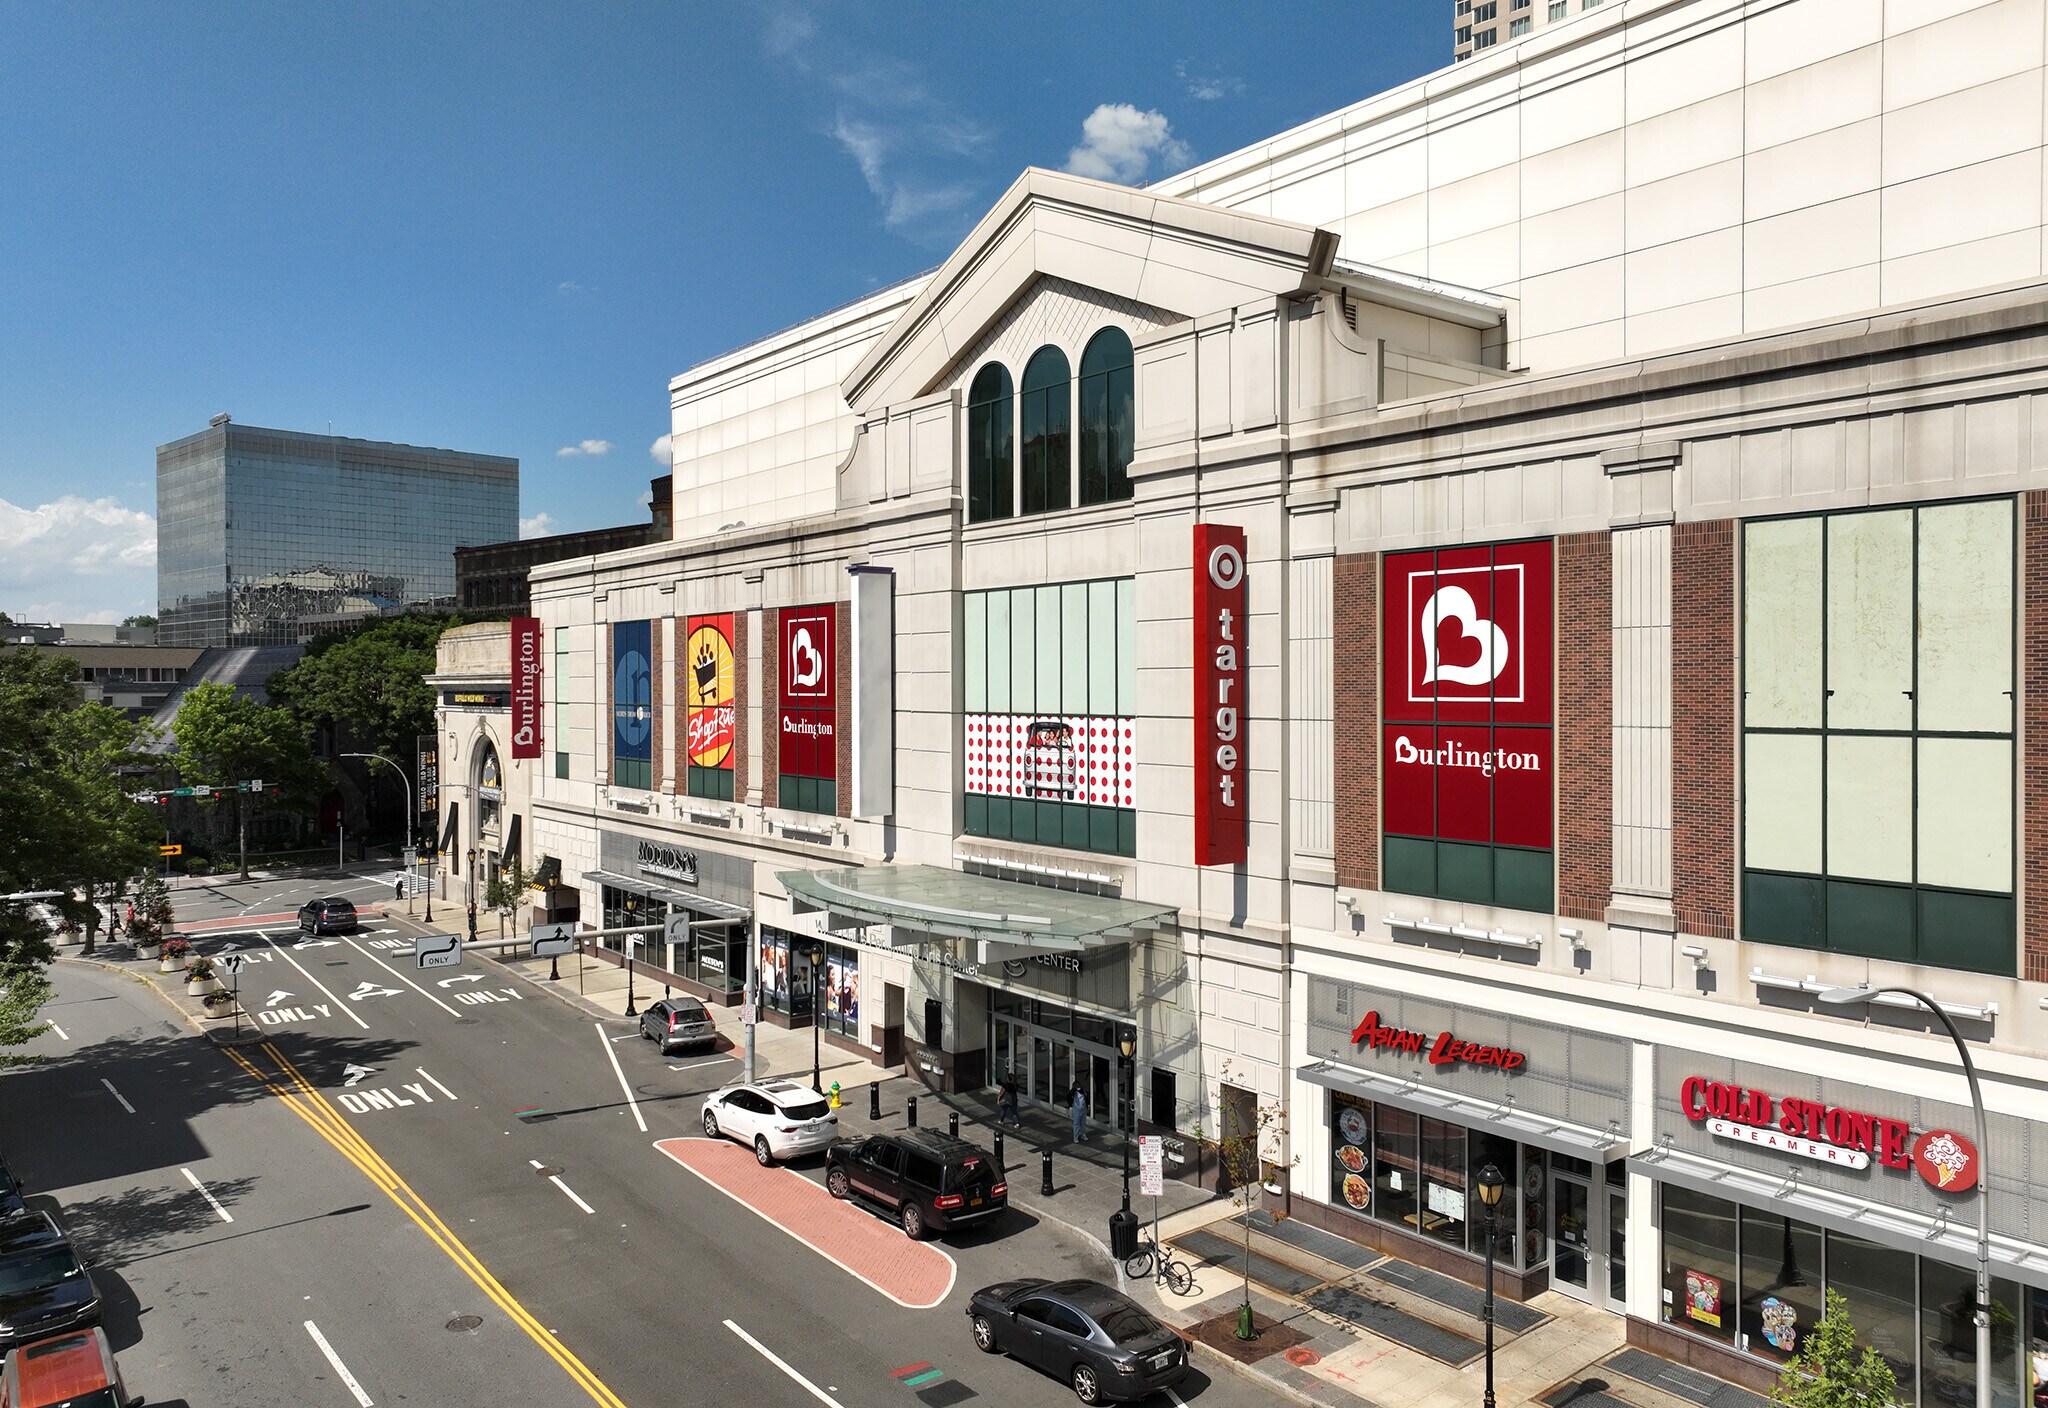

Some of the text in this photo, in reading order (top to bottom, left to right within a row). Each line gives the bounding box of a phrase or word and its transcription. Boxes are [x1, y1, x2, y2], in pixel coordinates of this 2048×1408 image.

[514, 631, 540, 746] Burlington
[1216, 608, 1237, 807] target
[689, 703, 735, 751] ShopRite
[783, 715, 833, 740] Burlington
[1395, 735, 1541, 778] Burlington
[637, 841, 698, 874] MORTON'S
[211, 951, 274, 967] OLY
[429, 956, 450, 965] ONLY
[257, 1004, 332, 1025] ONLY
[453, 987, 524, 1005] ONLY
[1350, 1010, 1526, 1070] ASIAN LEGEND
[337, 1082, 435, 1114] ONLY
[1680, 1076, 1910, 1171] COLD STONE
[1715, 1122, 1857, 1165] CREAMERY
